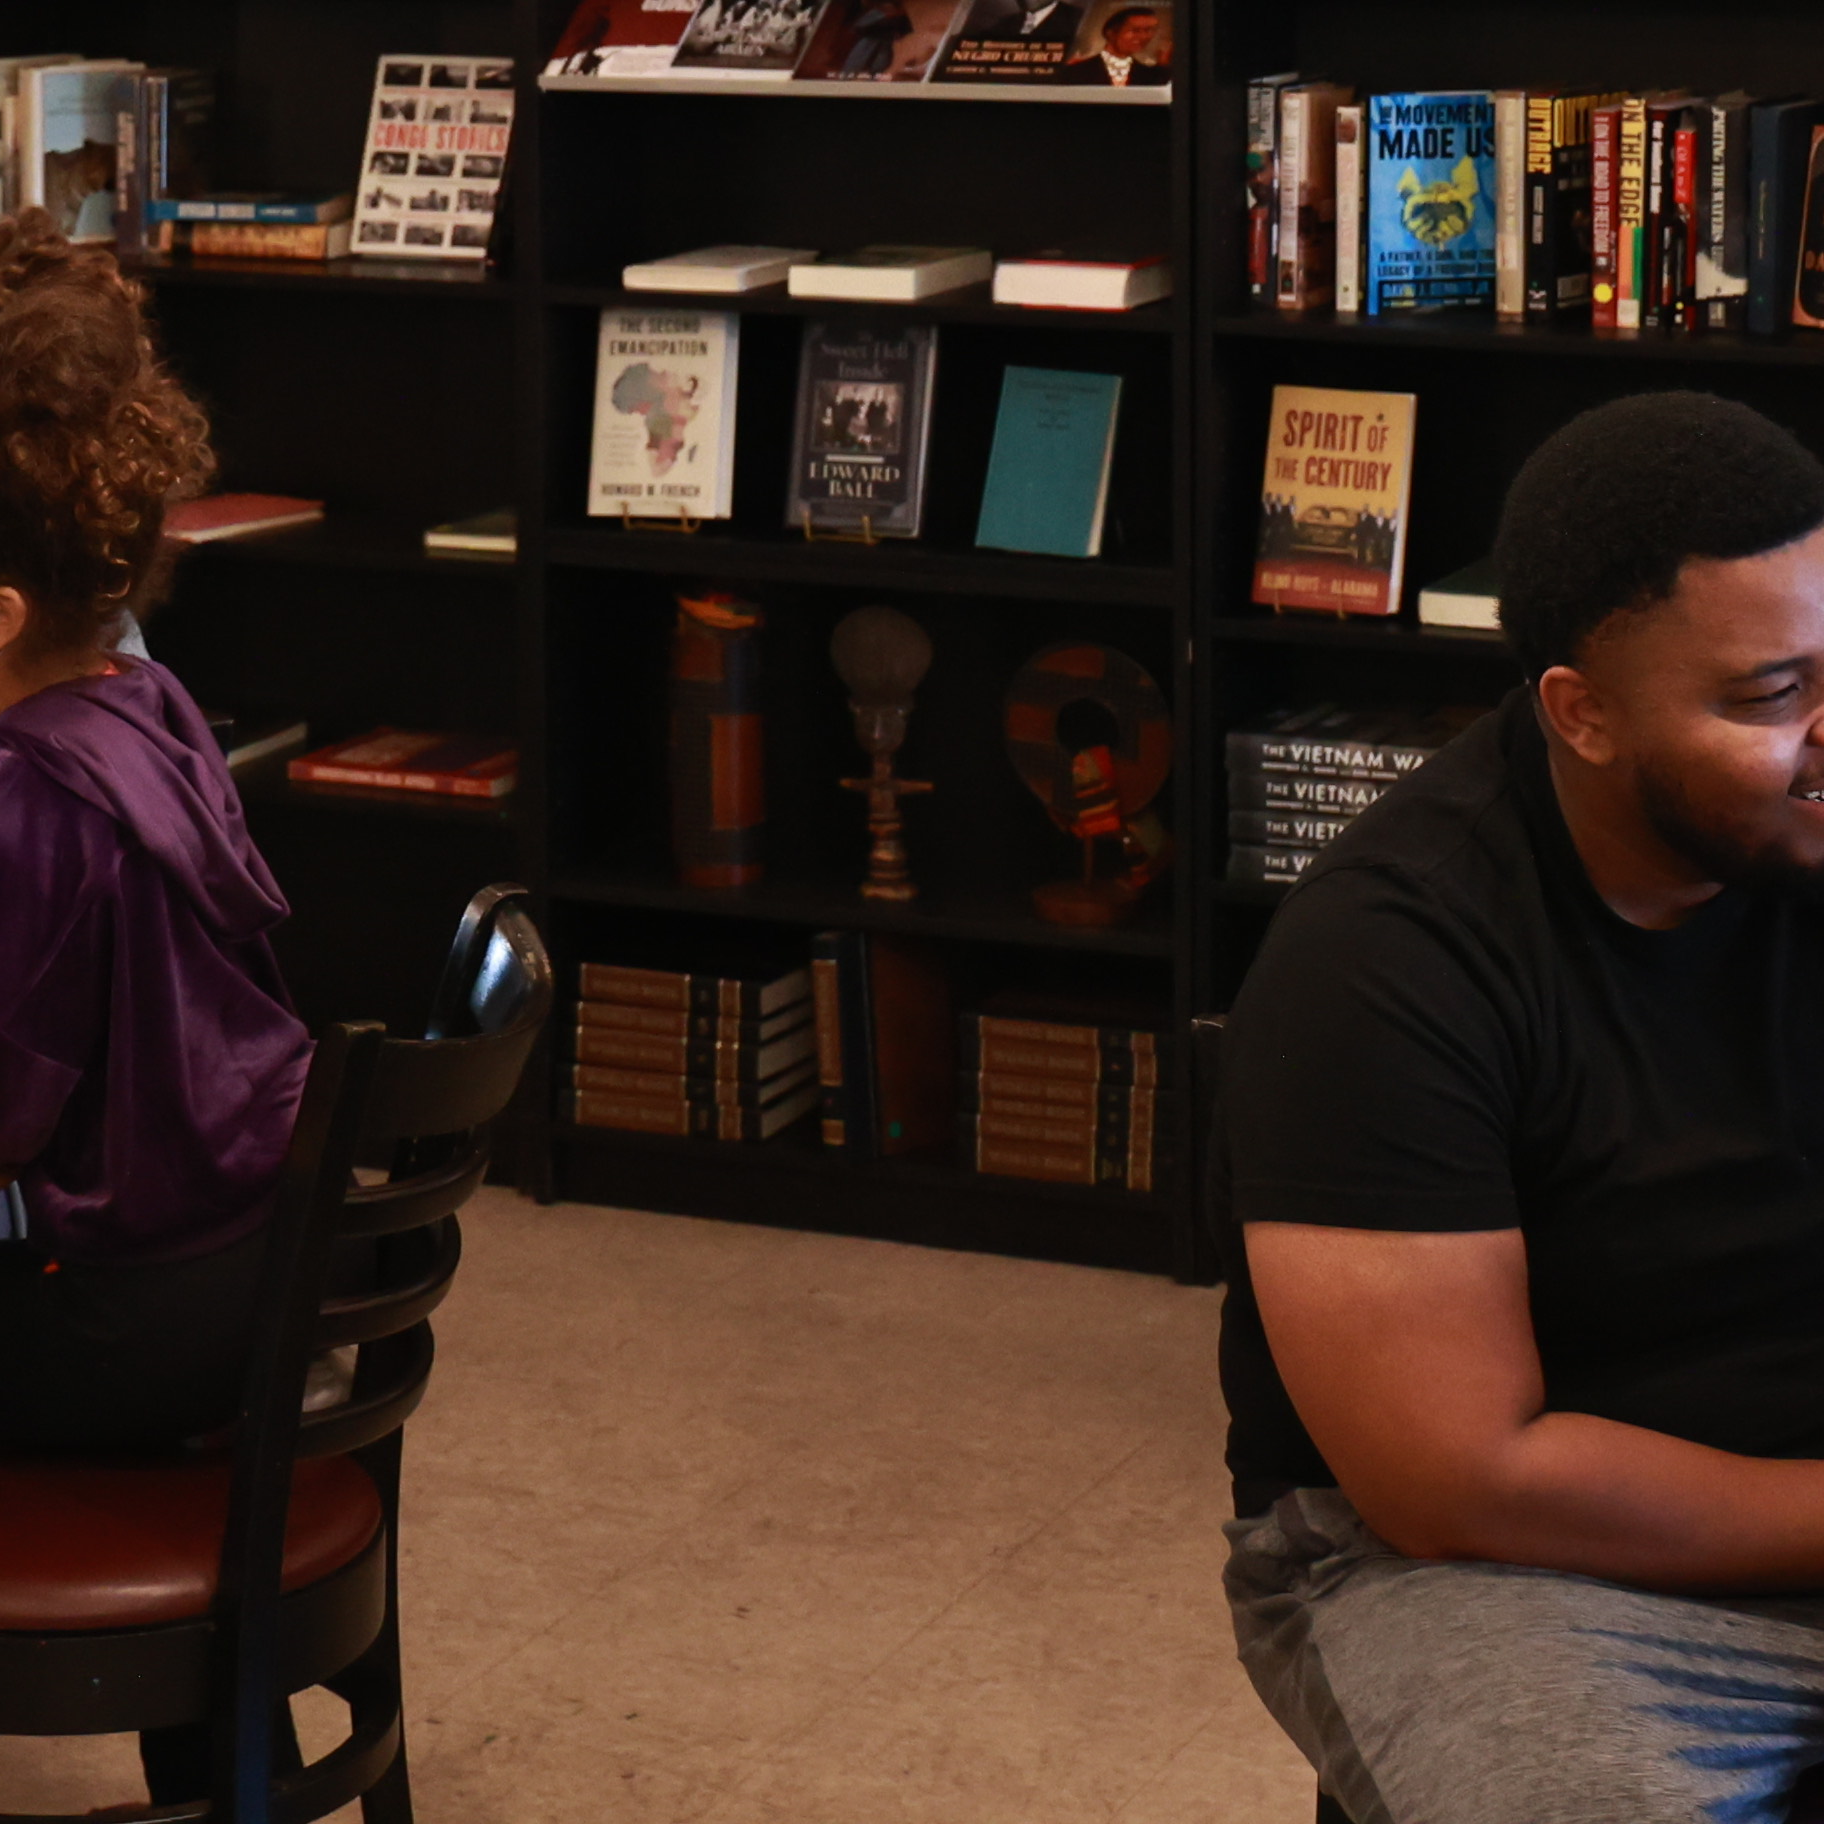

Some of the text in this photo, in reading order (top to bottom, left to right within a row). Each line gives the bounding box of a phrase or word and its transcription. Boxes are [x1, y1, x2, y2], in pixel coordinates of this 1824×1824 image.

[1378, 128, 1495, 160] MADE US
[1528, 98, 1552, 174] OUTRAGE
[1622, 131, 1643, 167] THE
[1620, 177, 1642, 228] EDGE
[609, 339, 708, 356] EMANCIPATION
[1283, 409, 1390, 453] SPIRIT OF
[809, 462, 900, 482] EDWARD
[1275, 455, 1393, 492] THE CENTURY
[828, 480, 876, 499] BALL
[1262, 743, 1285, 757] THE
[1290, 744, 1384, 769] VIETNAM
[1393, 752, 1425, 771] WA
[1266, 781, 1288, 796] THE
[1266, 820, 1345, 840] THE VIET
[1264, 855, 1287, 869] THE
